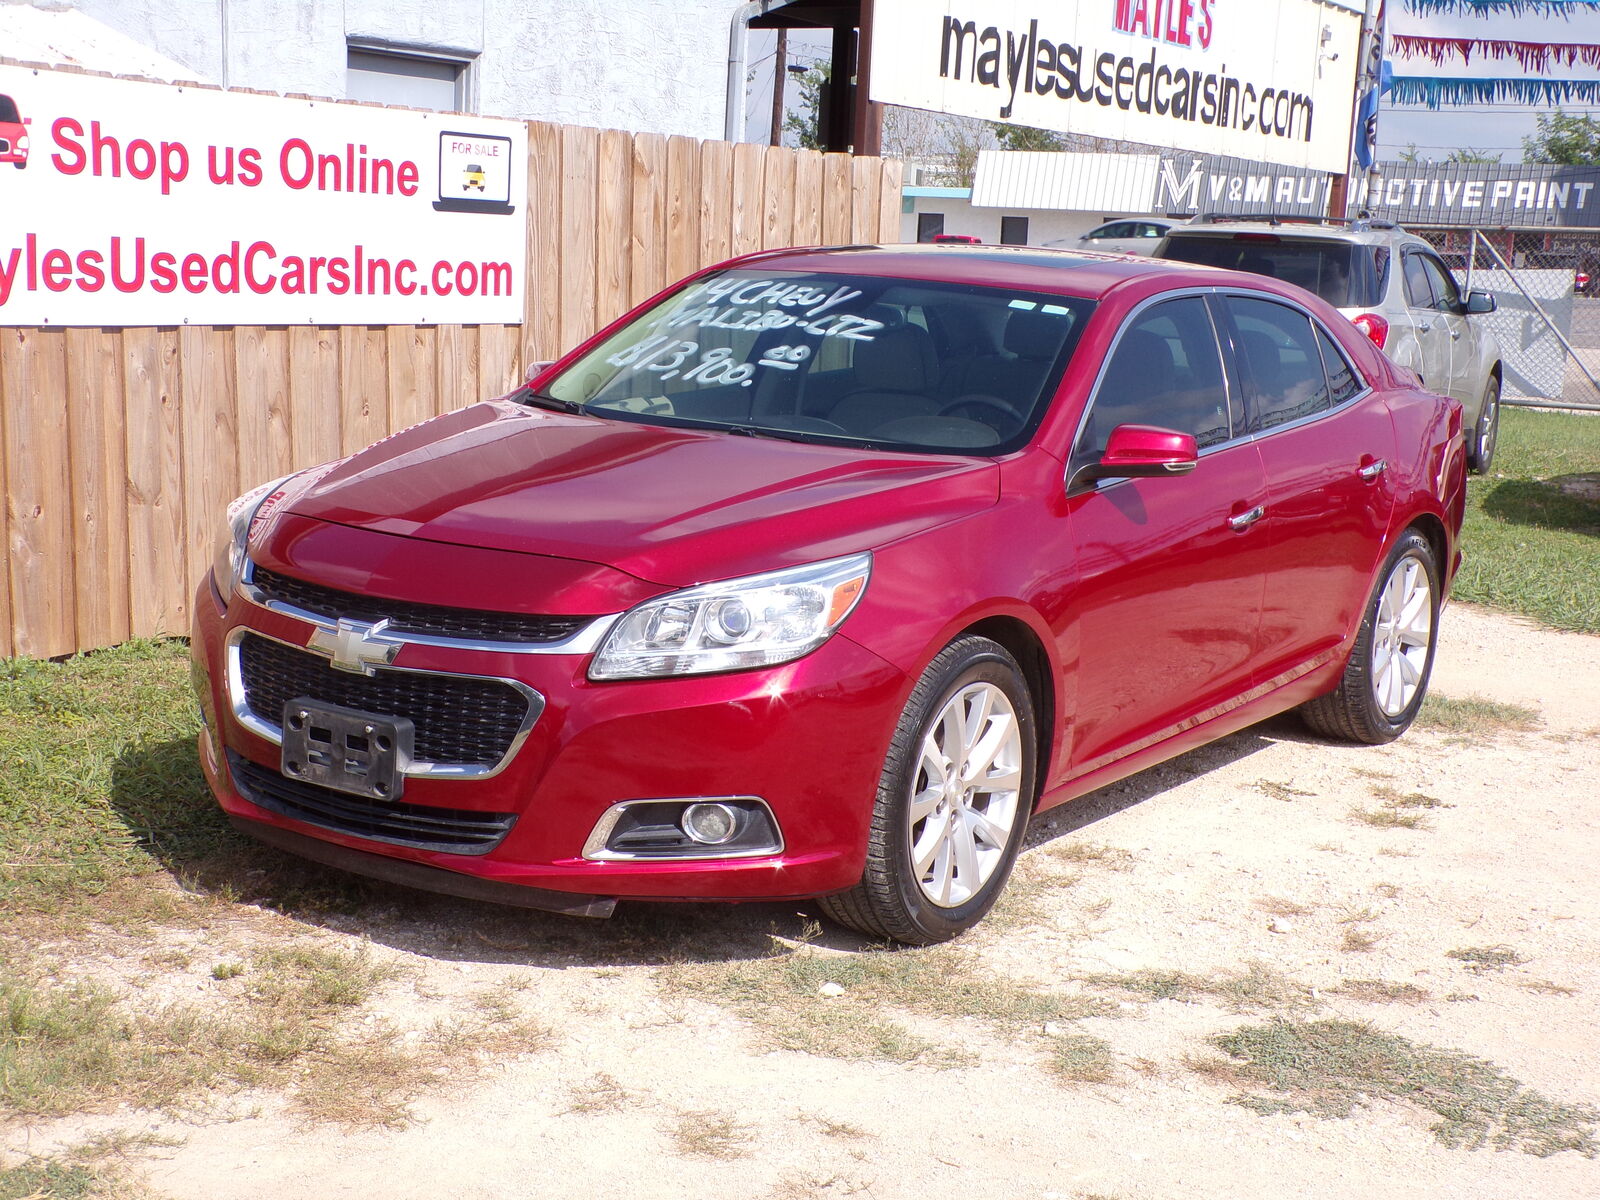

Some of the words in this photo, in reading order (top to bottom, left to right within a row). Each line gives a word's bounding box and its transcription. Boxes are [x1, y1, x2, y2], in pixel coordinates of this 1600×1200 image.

[51, 117, 189, 195] Shop
[208, 145, 263, 187] us
[280, 138, 419, 197] Online
[452, 142, 472, 154] FOR
[474, 144, 499, 157] SALE
[1209, 174, 1273, 203] V&M
[1490, 180, 1594, 209] PAINT
[0, 233, 513, 307] ylesUsedCarsInc.com
[728, 280, 862, 317] CHEVY
